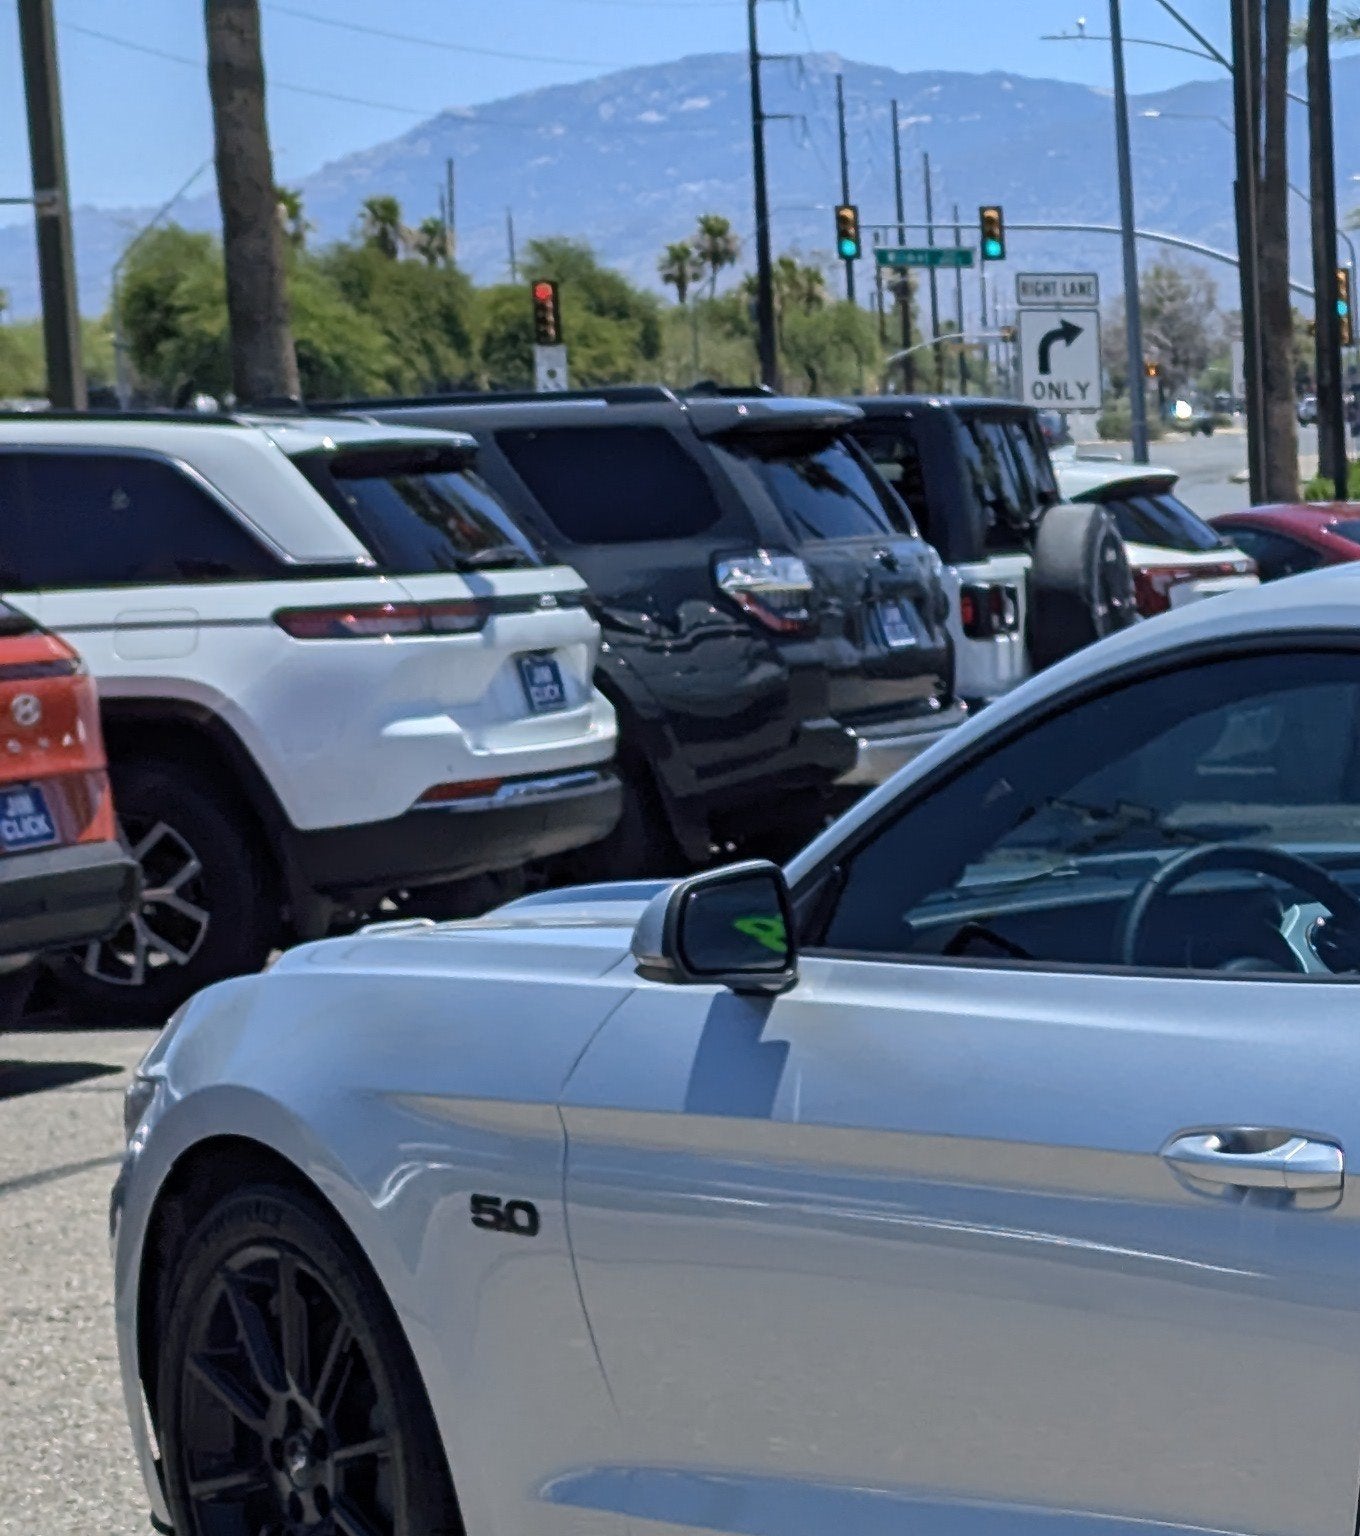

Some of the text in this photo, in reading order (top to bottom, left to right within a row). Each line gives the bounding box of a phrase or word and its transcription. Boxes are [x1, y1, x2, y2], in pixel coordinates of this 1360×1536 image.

[1021, 280, 1094, 297] RIGHT LANE
[1032, 380, 1090, 400] ONLY
